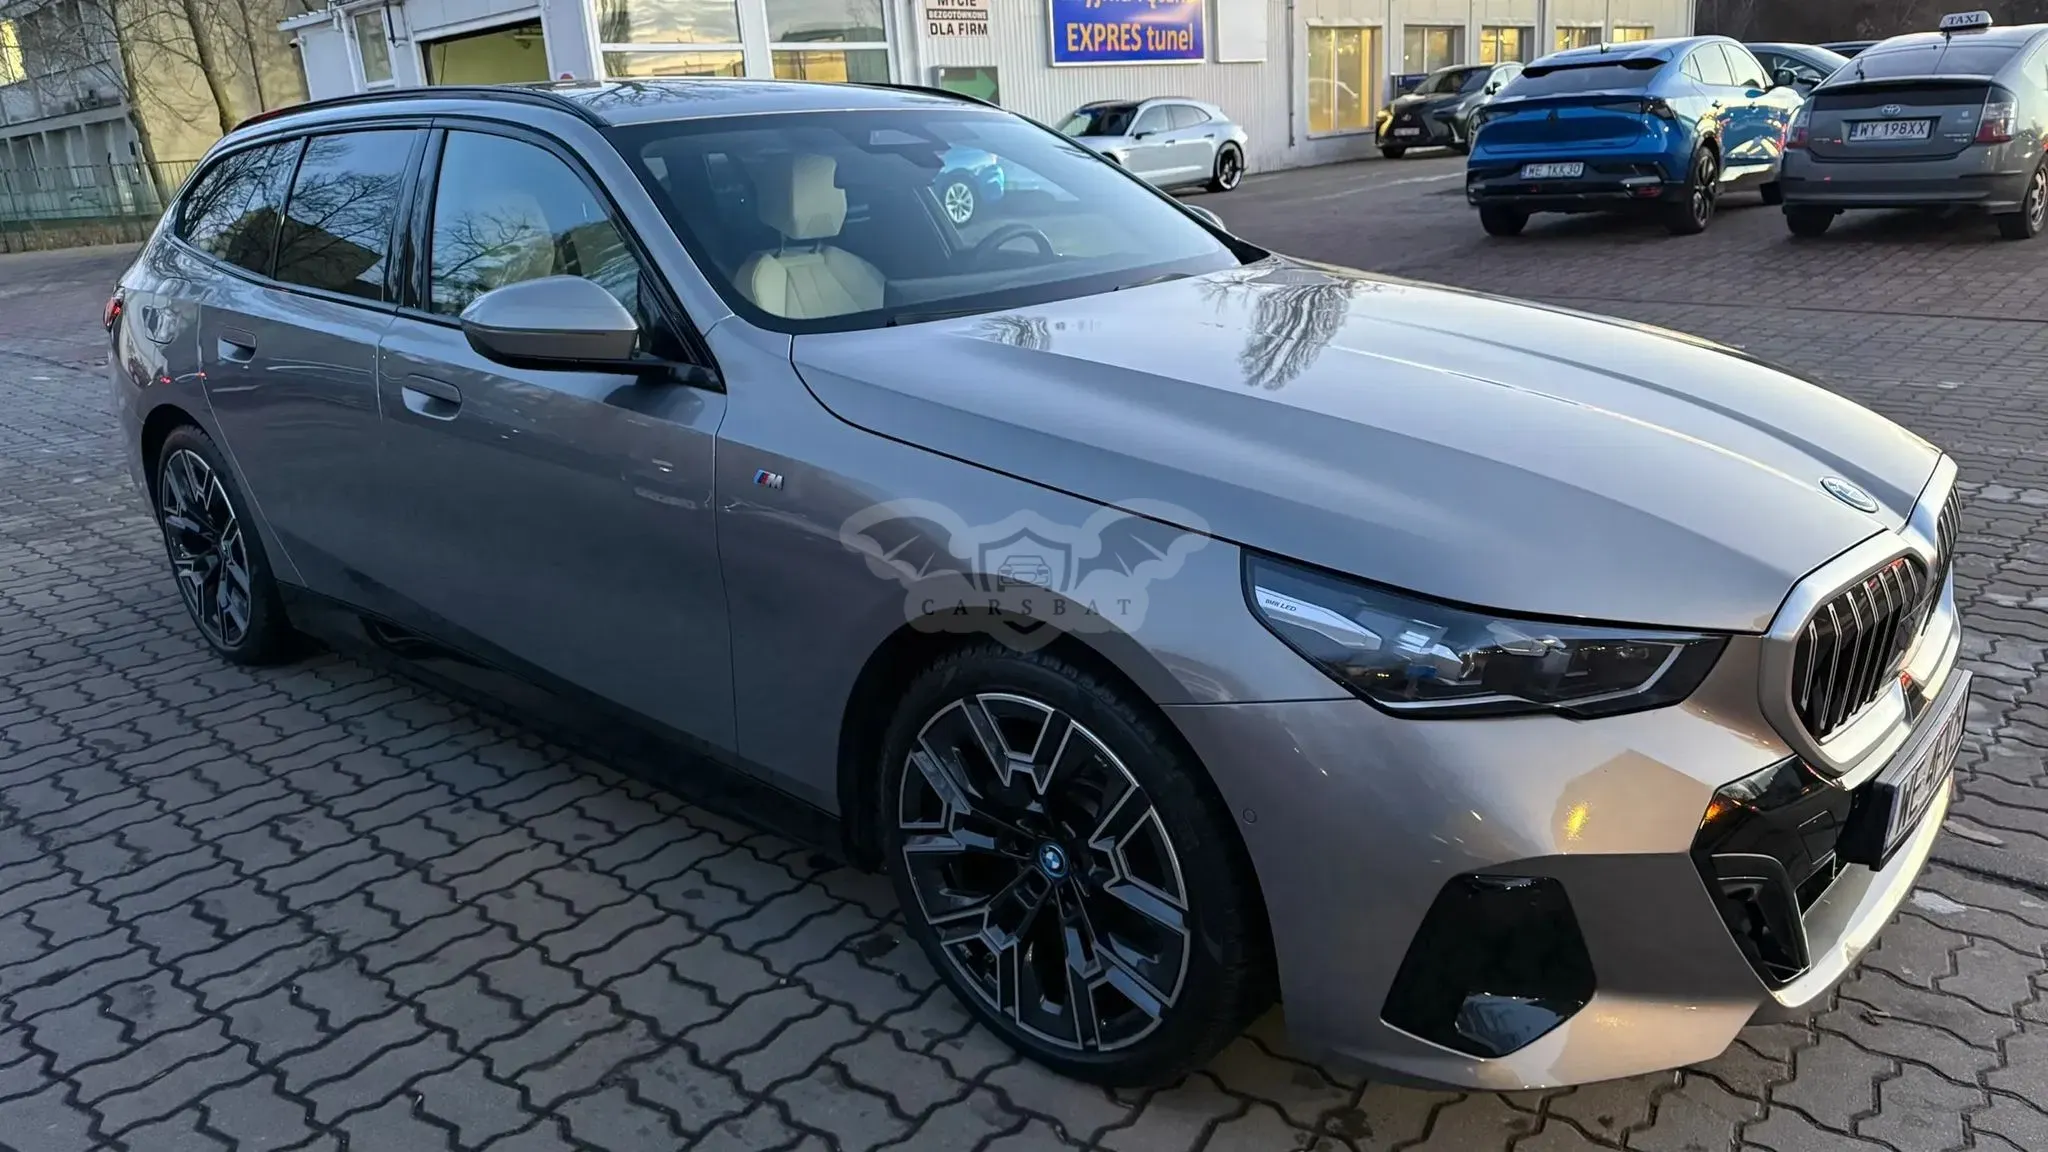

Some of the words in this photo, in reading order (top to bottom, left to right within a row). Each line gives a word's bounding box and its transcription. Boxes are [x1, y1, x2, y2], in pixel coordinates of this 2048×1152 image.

[1948, 14, 1980, 25] TAXI
[930, 22, 954, 36] DLA
[958, 22, 988, 36] FIRM
[1066, 22, 1142, 51] EXPRES
[1146, 22, 1194, 51] tunel
[1860, 123, 1878, 136] WY
[1884, 121, 1927, 136] 198XX
[1280, 603, 1297, 611] LED
